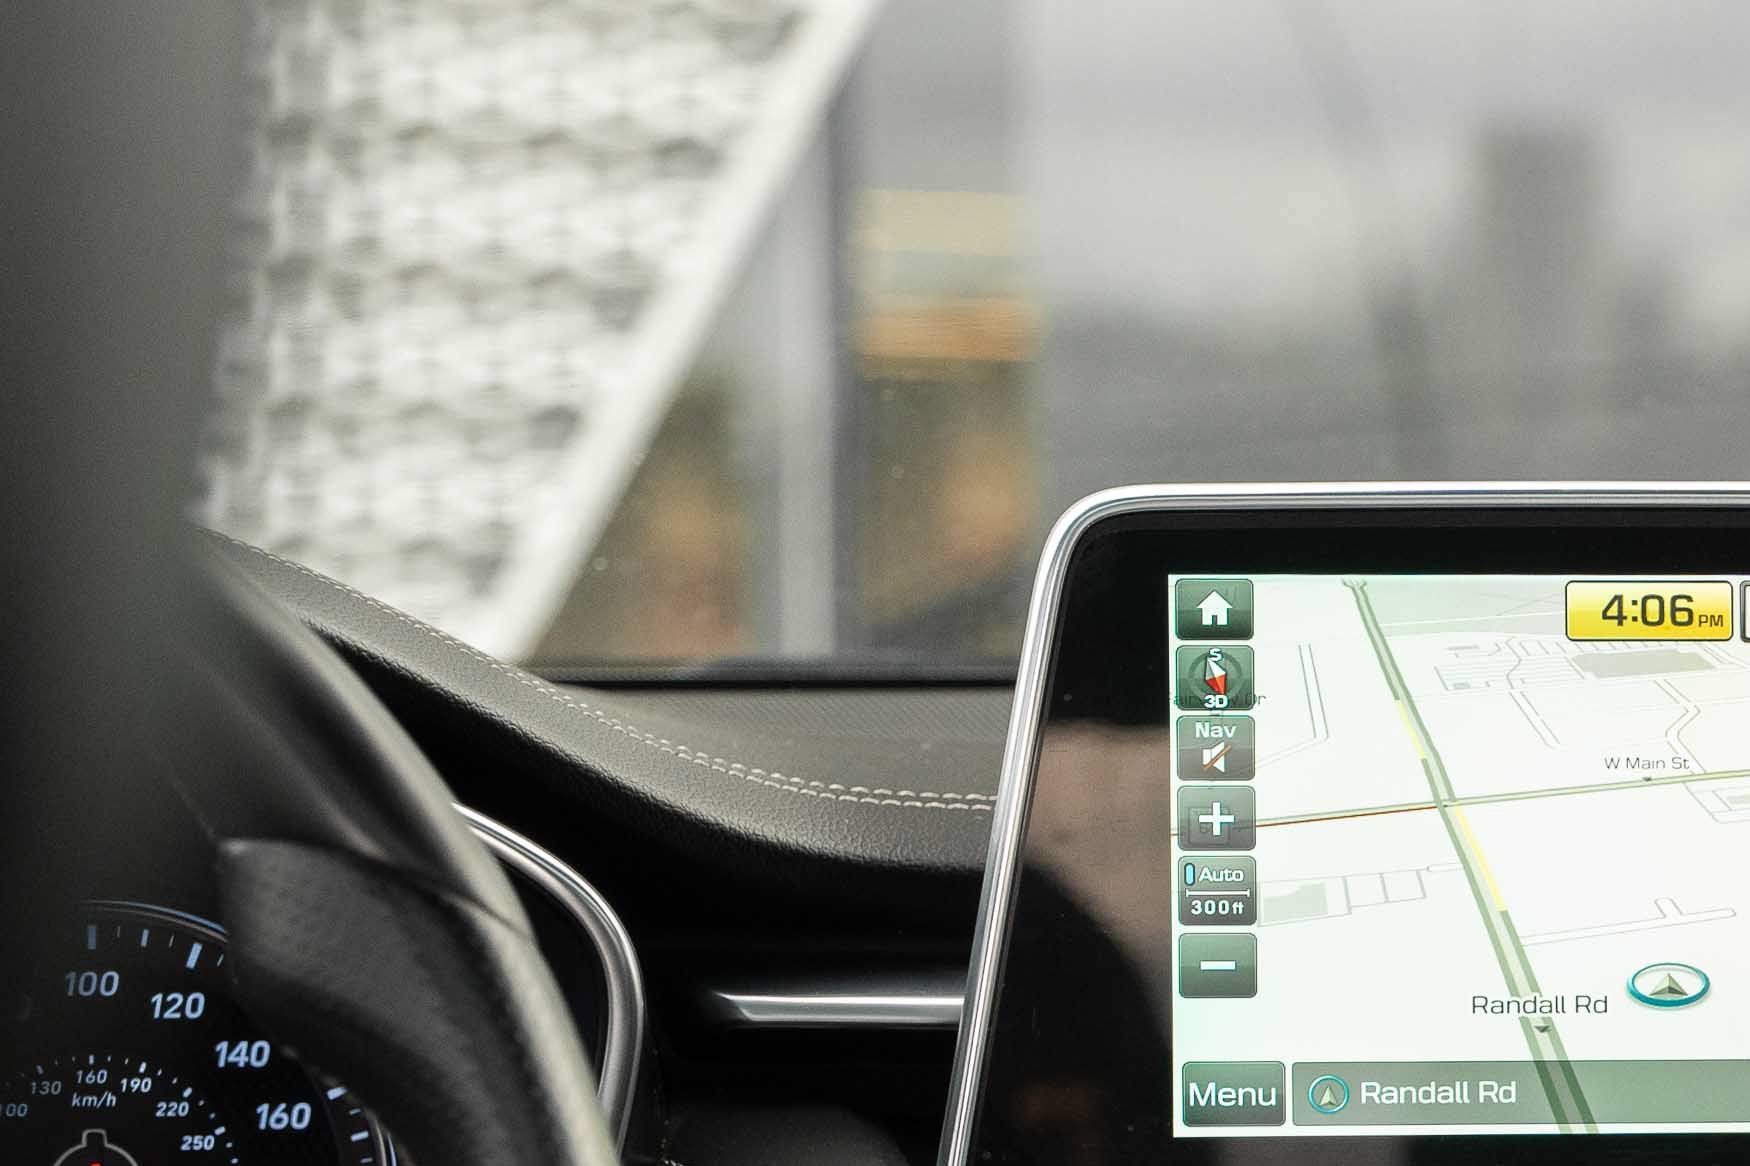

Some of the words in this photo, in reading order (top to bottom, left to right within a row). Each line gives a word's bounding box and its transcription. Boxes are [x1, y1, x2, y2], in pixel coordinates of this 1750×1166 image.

[1601, 593, 1694, 627] 4:06
[1698, 613, 1724, 628] PM
[1209, 648, 1222, 662] S
[1204, 694, 1229, 709] 3D
[1195, 722, 1237, 738] Nav
[1604, 757, 1622, 770] W
[1627, 756, 1668, 770] Main
[1673, 756, 1690, 770] St
[1198, 866, 1244, 882] Auto
[65, 970, 120, 997] 100
[150, 992, 206, 1020] 120
[1471, 995, 1566, 1015] Randall
[1574, 995, 1608, 1015] Rd
[215, 1040, 271, 1069] 140
[76, 1069, 108, 1085] 160
[31, 1080, 62, 1095] 130
[120, 1078, 152, 1094] 190
[1361, 1081, 1471, 1105] Randall
[1479, 1081, 1516, 1103] Rd
[72, 1091, 117, 1109] km/h
[1189, 1082, 1277, 1108] Menu
[156, 1102, 189, 1118] 220
[256, 1102, 312, 1131] 160
[180, 1135, 215, 1151] 250
